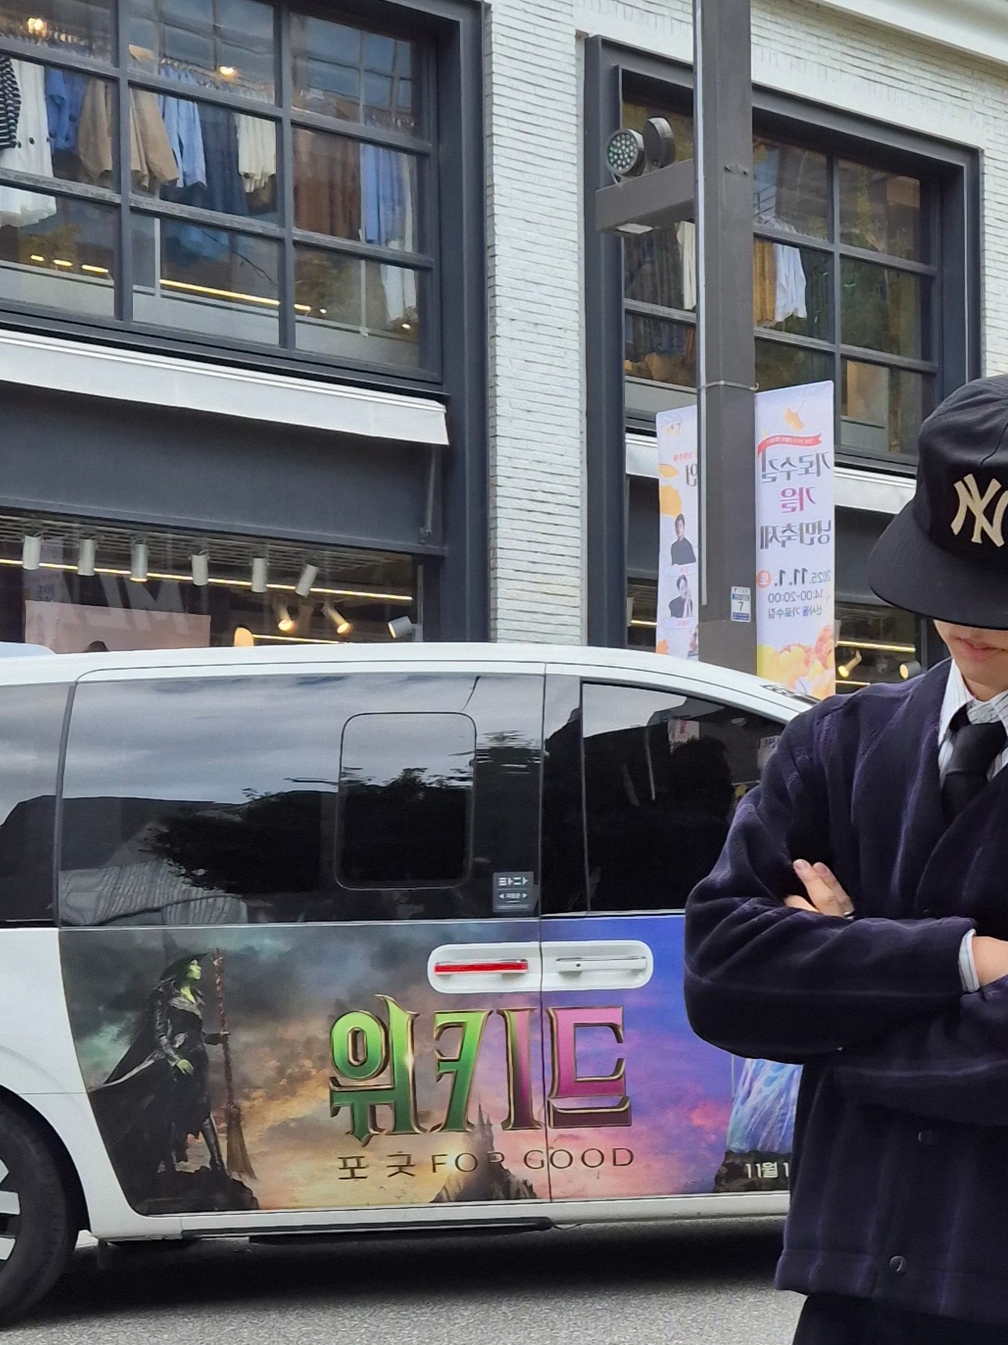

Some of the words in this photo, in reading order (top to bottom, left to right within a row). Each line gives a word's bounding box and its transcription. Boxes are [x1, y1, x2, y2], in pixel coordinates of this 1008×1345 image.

[737, 601, 744, 611] 7
[329, 994, 632, 1147] 위키드
[338, 1154, 369, 1180] 포
[386, 1151, 416, 1177] 굿
[431, 1150, 505, 1173] FOR
[523, 1147, 635, 1170] GOOD
[745, 1162, 779, 1179] 11월
